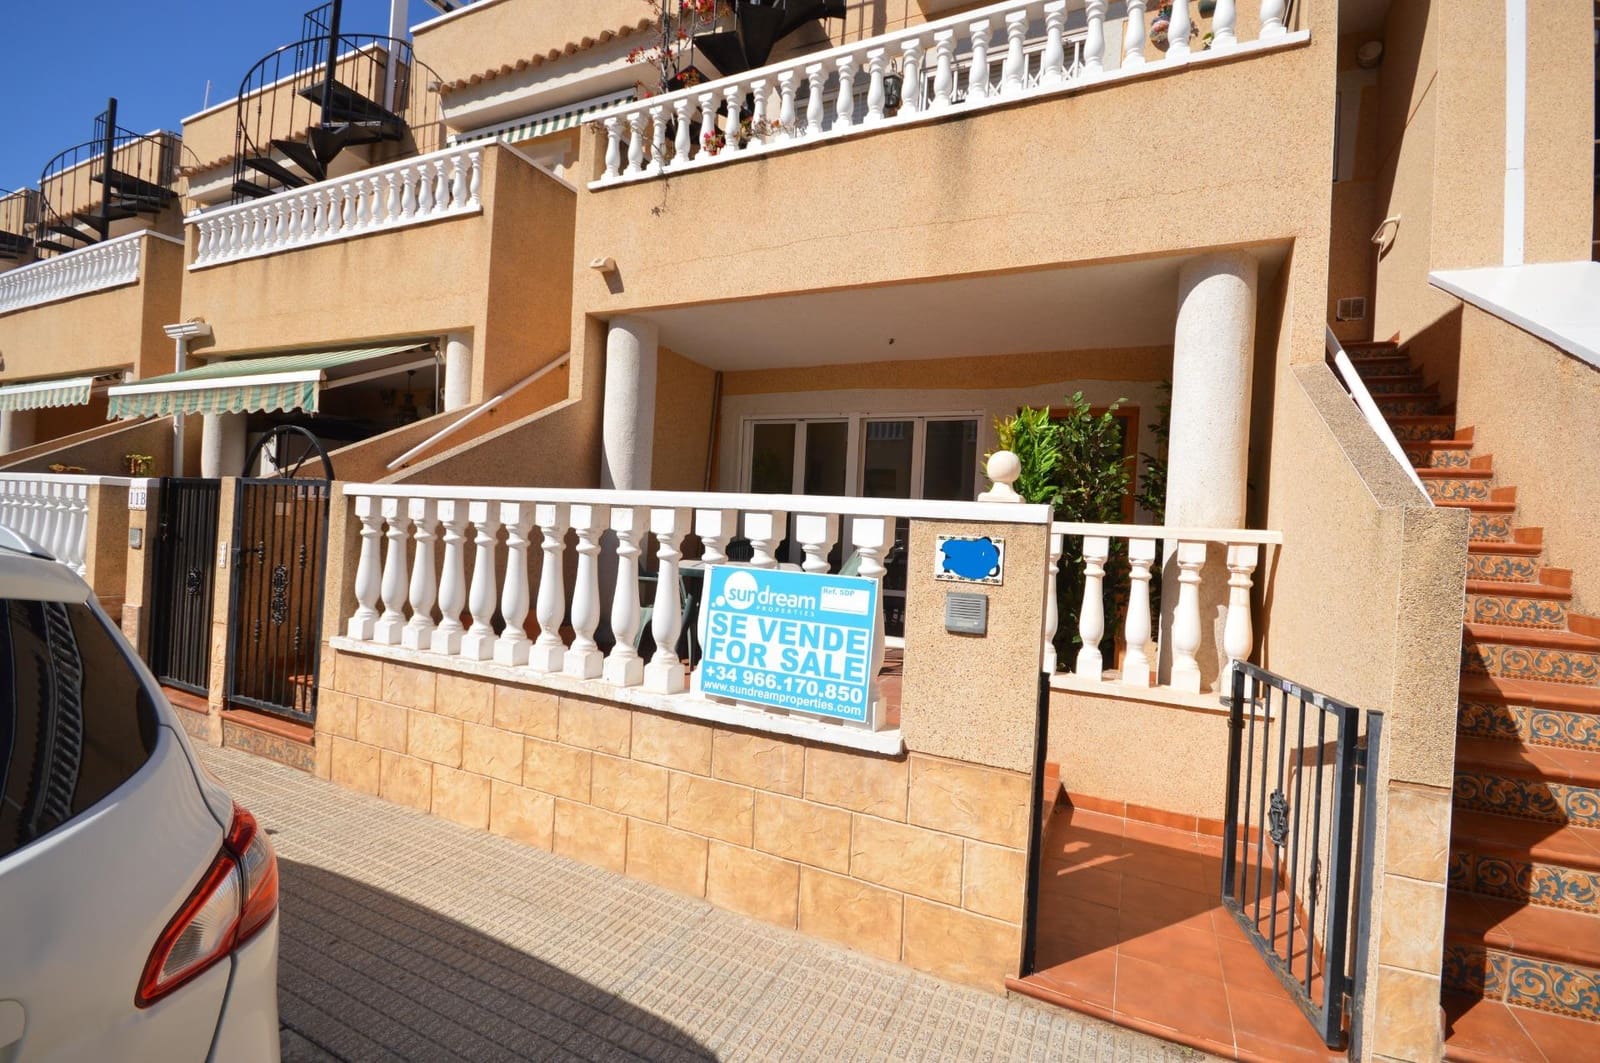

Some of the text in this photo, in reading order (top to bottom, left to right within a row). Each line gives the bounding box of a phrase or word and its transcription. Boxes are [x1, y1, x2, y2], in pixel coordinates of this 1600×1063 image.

[756, 606, 815, 617] PROPERTIES
[711, 612, 867, 656] SE VENDE
[709, 637, 865, 683] FOR SALE
[704, 680, 862, 716] www.sundreamproperties.com
[705, 665, 863, 704] +34 966.170.850
